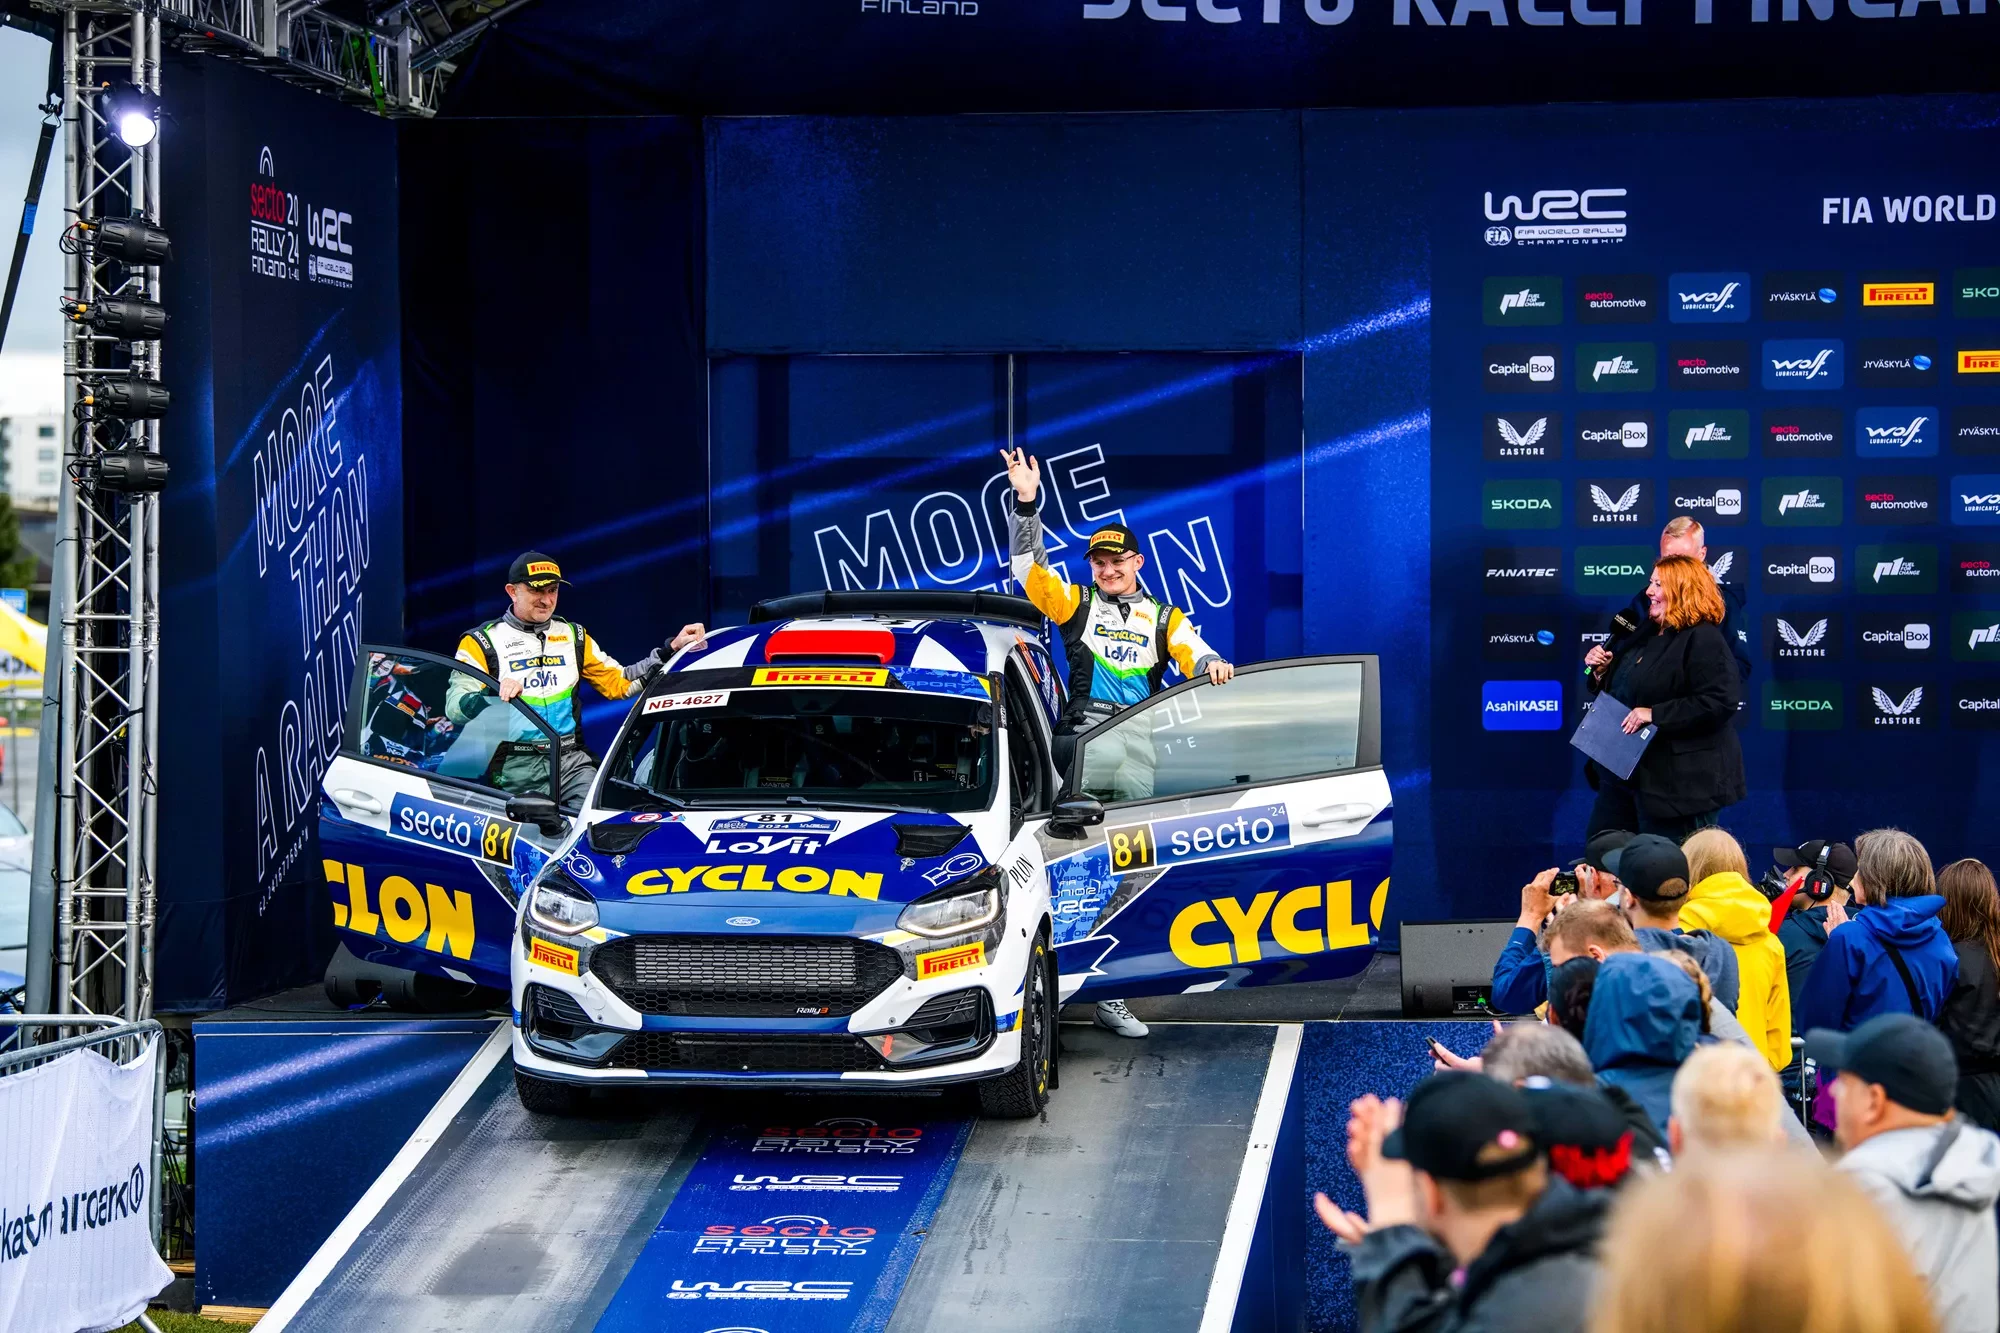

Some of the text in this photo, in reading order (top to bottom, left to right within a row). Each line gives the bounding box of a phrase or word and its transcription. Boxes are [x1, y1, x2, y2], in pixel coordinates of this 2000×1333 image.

[251, 182, 285, 224] secto
[1484, 188, 1627, 221] WRC
[1822, 194, 1997, 224] FIA WORLD
[287, 193, 299, 227] 20
[307, 203, 353, 256] WRC
[287, 231, 300, 265] 24
[1518, 238, 1624, 246] CHAMPIONSHIP
[1770, 291, 1816, 302] JYVÄSKYLÄ
[1869, 287, 1928, 301] PIRELLI
[1590, 299, 1646, 308] automotive
[1678, 358, 1706, 366] secto
[1864, 358, 1911, 368] JYVÄSKYLÄ
[1682, 365, 1740, 374] automotive
[1770, 426, 1799, 434] secto
[1776, 432, 1833, 442] automotive
[1500, 448, 1545, 456] CASTORE
[252, 353, 343, 578] MORE
[1870, 500, 1928, 510] automotive
[813, 443, 1127, 591] MORE
[1592, 514, 1638, 522] CASTORE
[1091, 534, 1122, 544] PIRELLI
[289, 453, 371, 661] THAN
[1960, 560, 1990, 568] secto
[1486, 568, 1556, 577] FANATEC
[1489, 634, 1535, 643] JYVÄSKYLÄ
[766, 671, 876, 682] PIRELLI
[648, 694, 724, 711] NB-4627
[256, 747, 278, 883] A
[757, 814, 793, 822] 81
[400, 806, 471, 847] secto
[484, 822, 512, 860] 81
[1171, 814, 1274, 856] secto
[1112, 830, 1149, 868] 81
[626, 864, 885, 902] CYCLON
[533, 943, 574, 970] PIRELLI
[924, 948, 980, 974] PIRELLI
[762, 1125, 923, 1138] secto
[733, 1174, 904, 1186] WRC
[704, 1225, 877, 1238] secto
[671, 1280, 854, 1292] WRC
